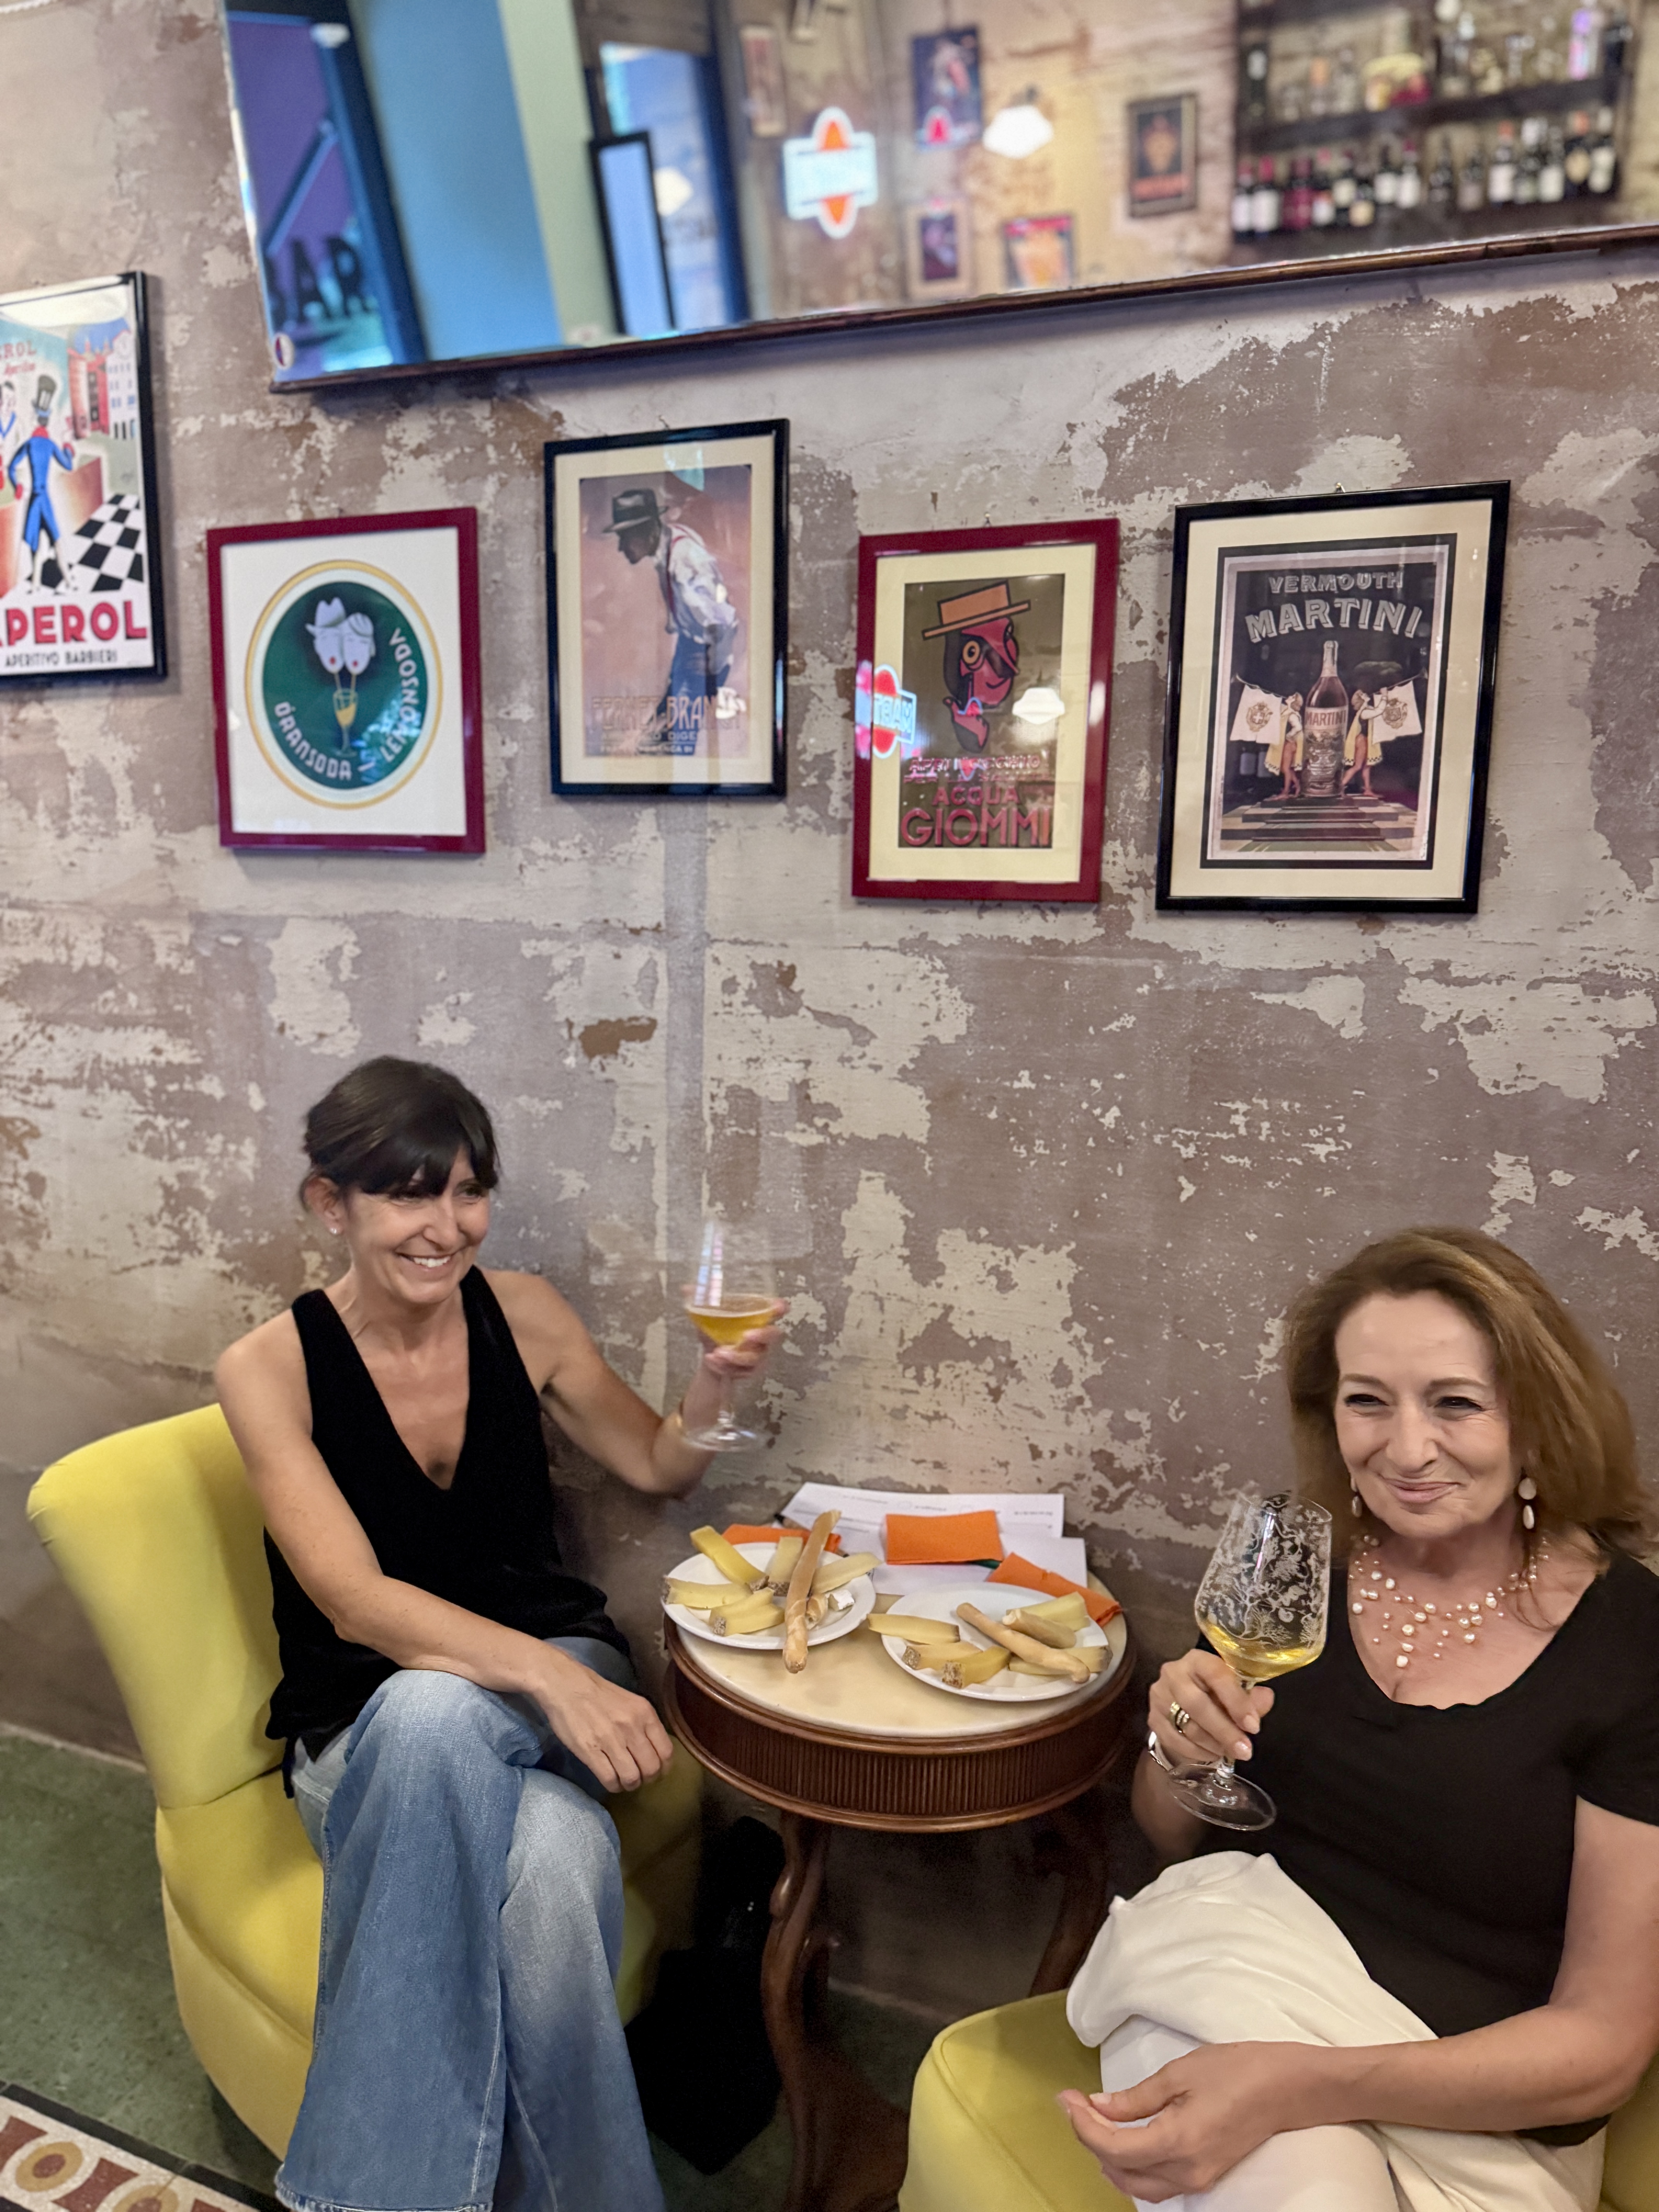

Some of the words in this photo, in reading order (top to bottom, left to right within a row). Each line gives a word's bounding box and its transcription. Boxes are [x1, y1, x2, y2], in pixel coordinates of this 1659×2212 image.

[1268, 572, 1403, 594] VERMOUTH
[0, 601, 147, 647] PEROL
[1245, 598, 1422, 643] MARTINI
[5, 652, 59, 667] APERITIVO
[65, 649, 118, 664] BARBIERI
[380, 627, 419, 762] LEMONSODA
[1305, 709, 1346, 726] MARTINI
[932, 786, 1020, 806] ACQUA
[901, 807, 1050, 846] GIOMMI
